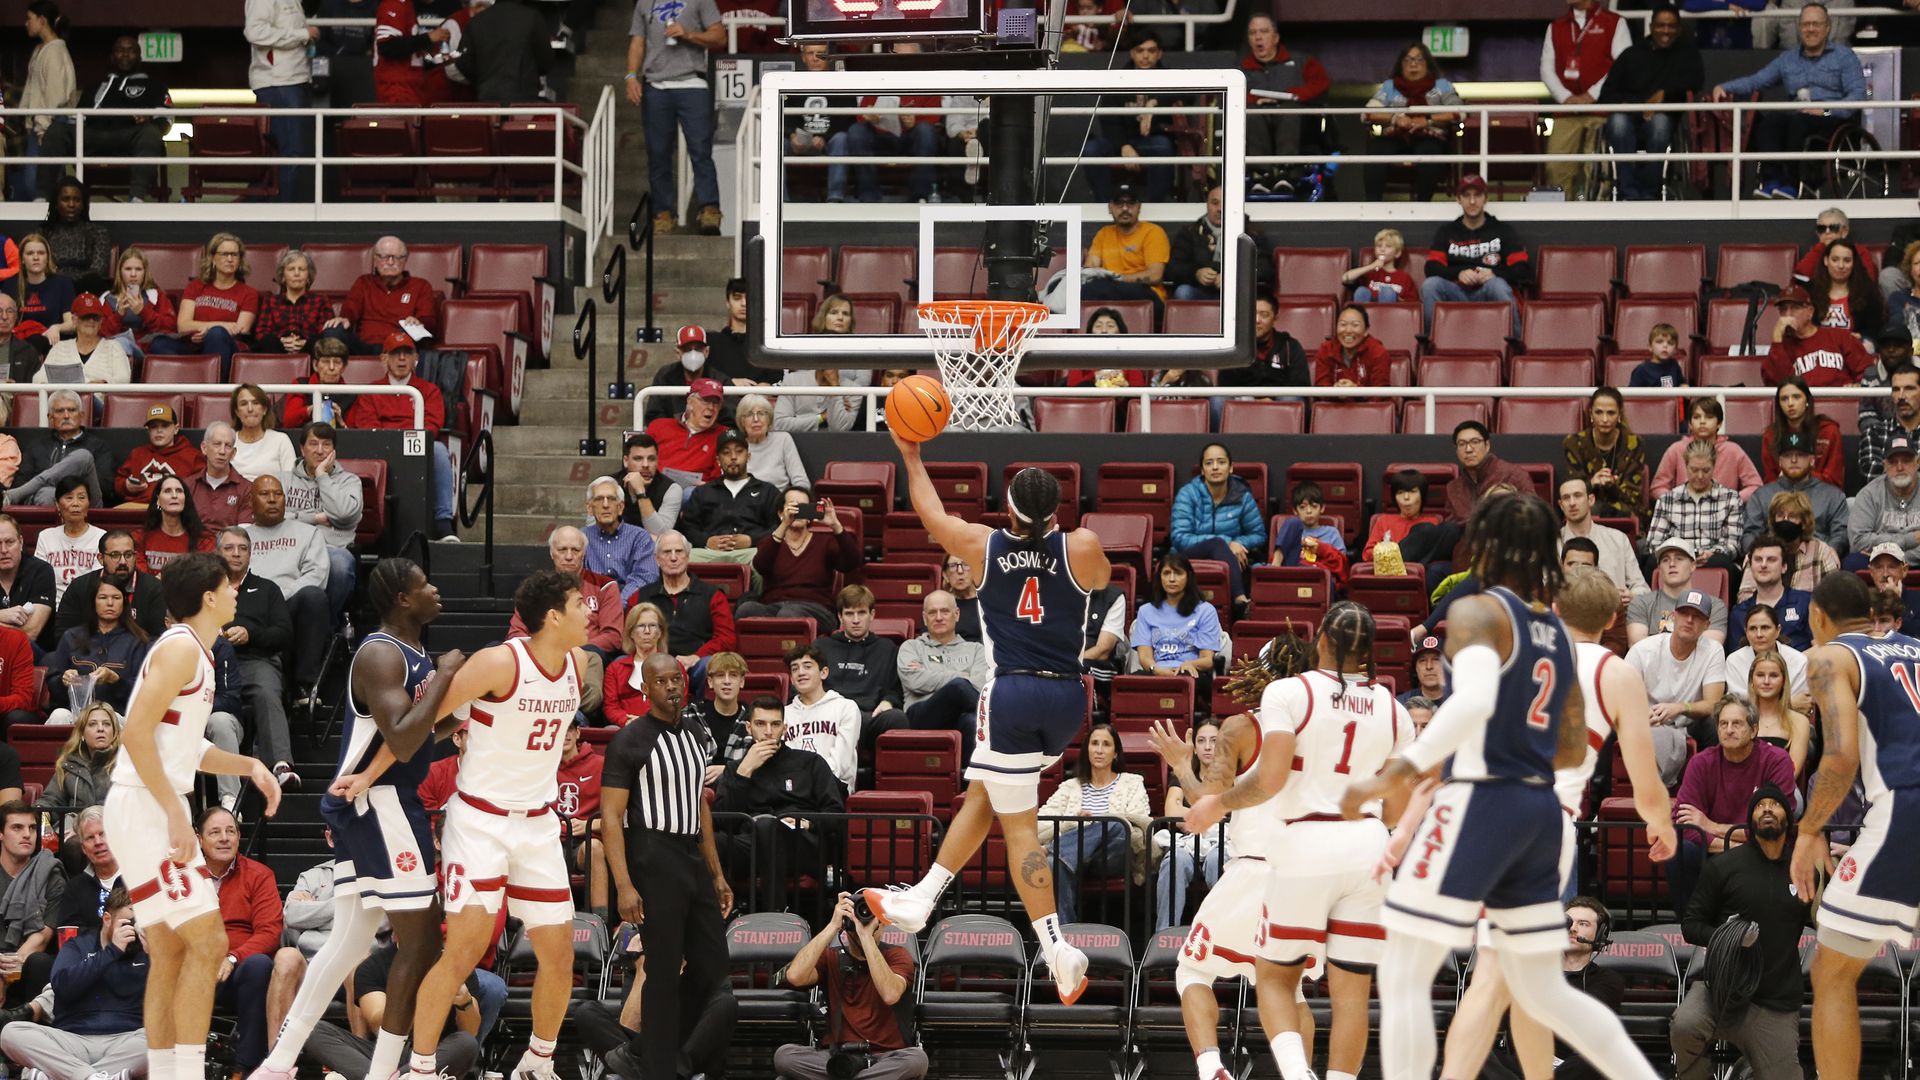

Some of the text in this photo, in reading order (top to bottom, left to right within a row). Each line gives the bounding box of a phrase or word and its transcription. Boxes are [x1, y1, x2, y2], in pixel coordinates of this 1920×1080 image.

[145, 33, 177, 58] EXIT
[722, 73, 745, 99] 15
[1448, 237, 1501, 258] 49ERS
[626, 348, 649, 369] D
[601, 405, 620, 425] C
[406, 438, 422, 454] 16
[569, 462, 592, 481] B
[1016, 576, 1045, 624] 4
[1526, 656, 1557, 730] 2
[1889, 662, 1920, 715] 1
[518, 697, 577, 713] STANFORD
[1331, 691, 1375, 716] BYNUM
[526, 718, 562, 751] 23
[783, 720, 838, 742] ARIZONA
[802, 737, 817, 752] A
[1333, 720, 1358, 775] 1
[1413, 803, 1454, 880] CATS
[733, 930, 803, 945] STANFORD
[944, 932, 1014, 947] STANFORD
